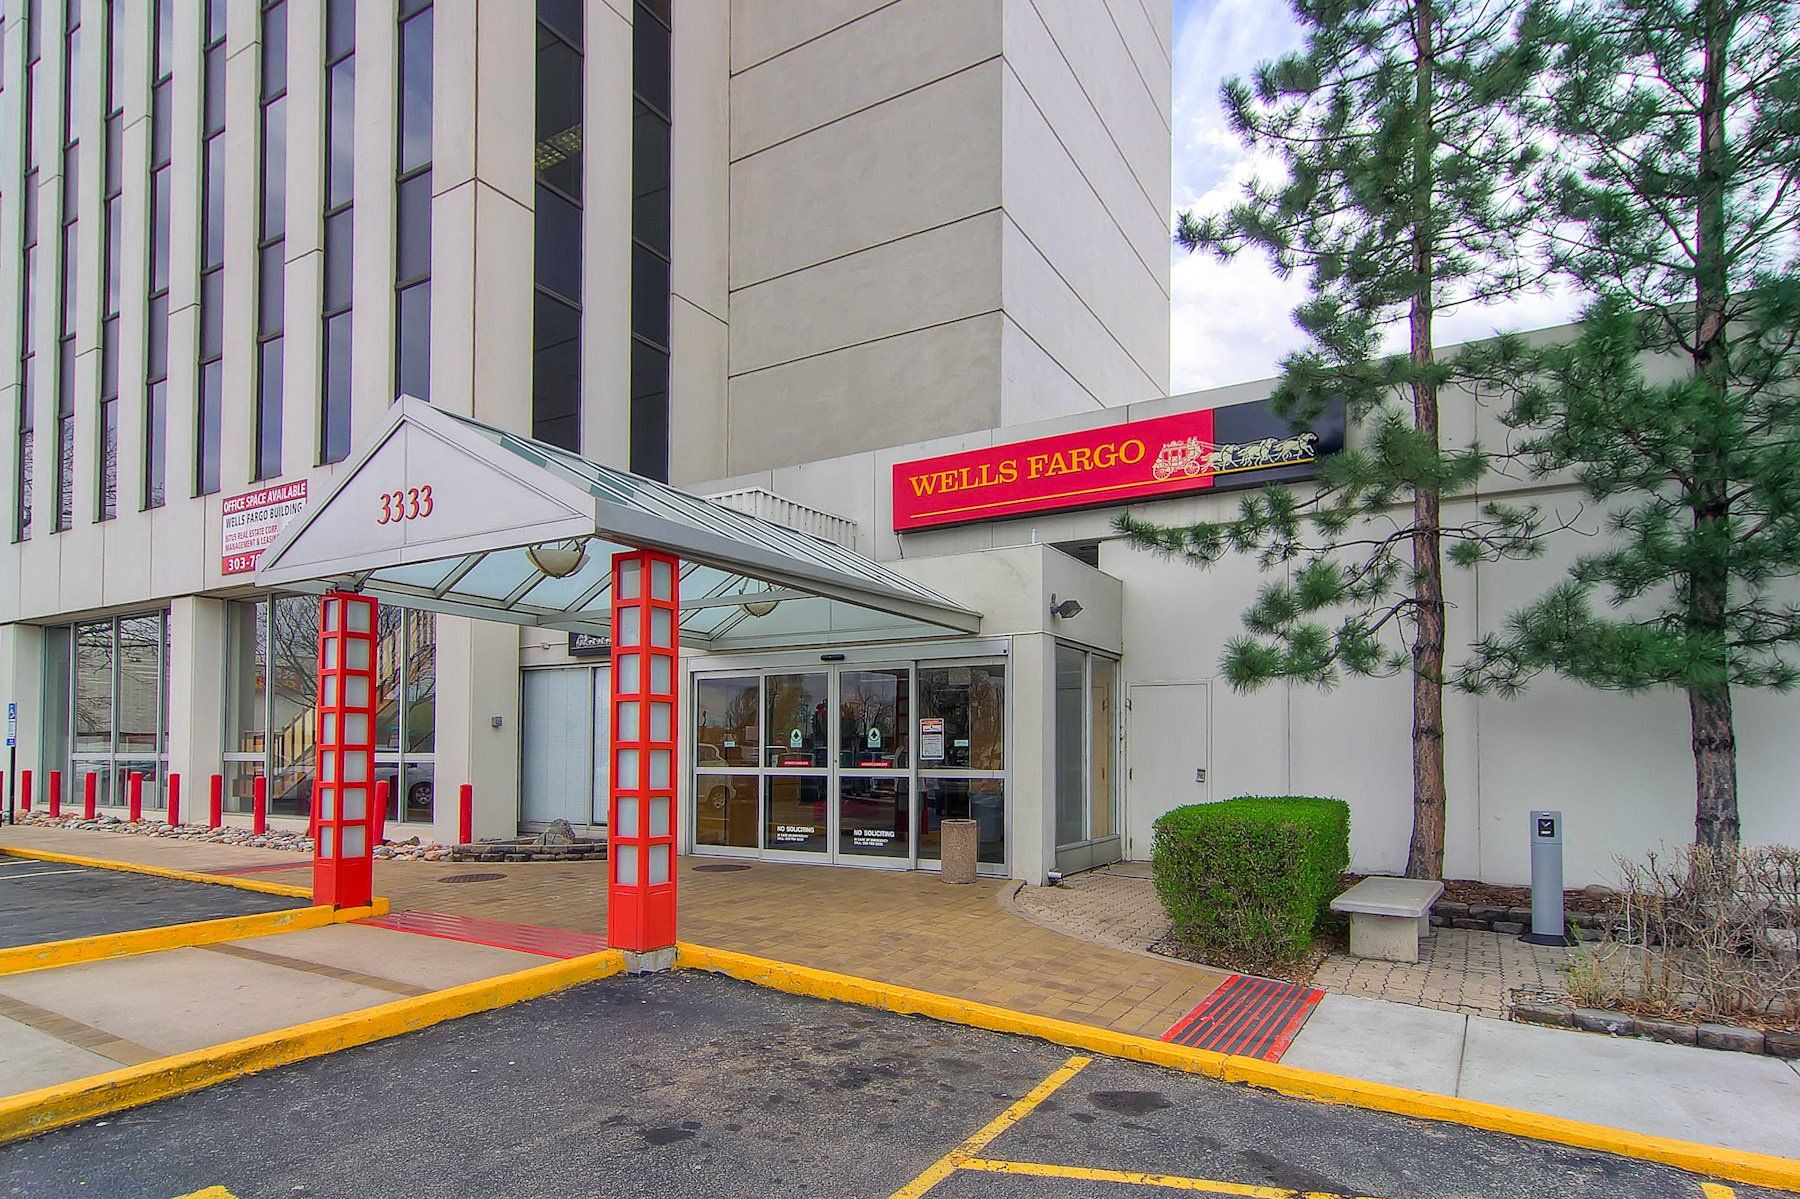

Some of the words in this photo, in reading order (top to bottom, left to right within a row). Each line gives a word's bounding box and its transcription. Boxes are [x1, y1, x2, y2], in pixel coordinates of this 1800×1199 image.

[908, 459, 1019, 497] WELLS
[1026, 439, 1146, 480] FARGO
[224, 498, 245, 512] OFFICE
[245, 492, 267, 507] SPACE
[267, 483, 306, 503] AVAILABLE
[377, 485, 433, 524] 3333
[226, 514, 245, 528] WELLS
[247, 509, 268, 524] FARGO
[270, 502, 303, 519] BUILDING
[225, 538, 256, 551] MANAGEMENT
[261, 533, 279, 545] LEASIN
[238, 530, 248, 540] REAL
[249, 527, 265, 538] ESTATE
